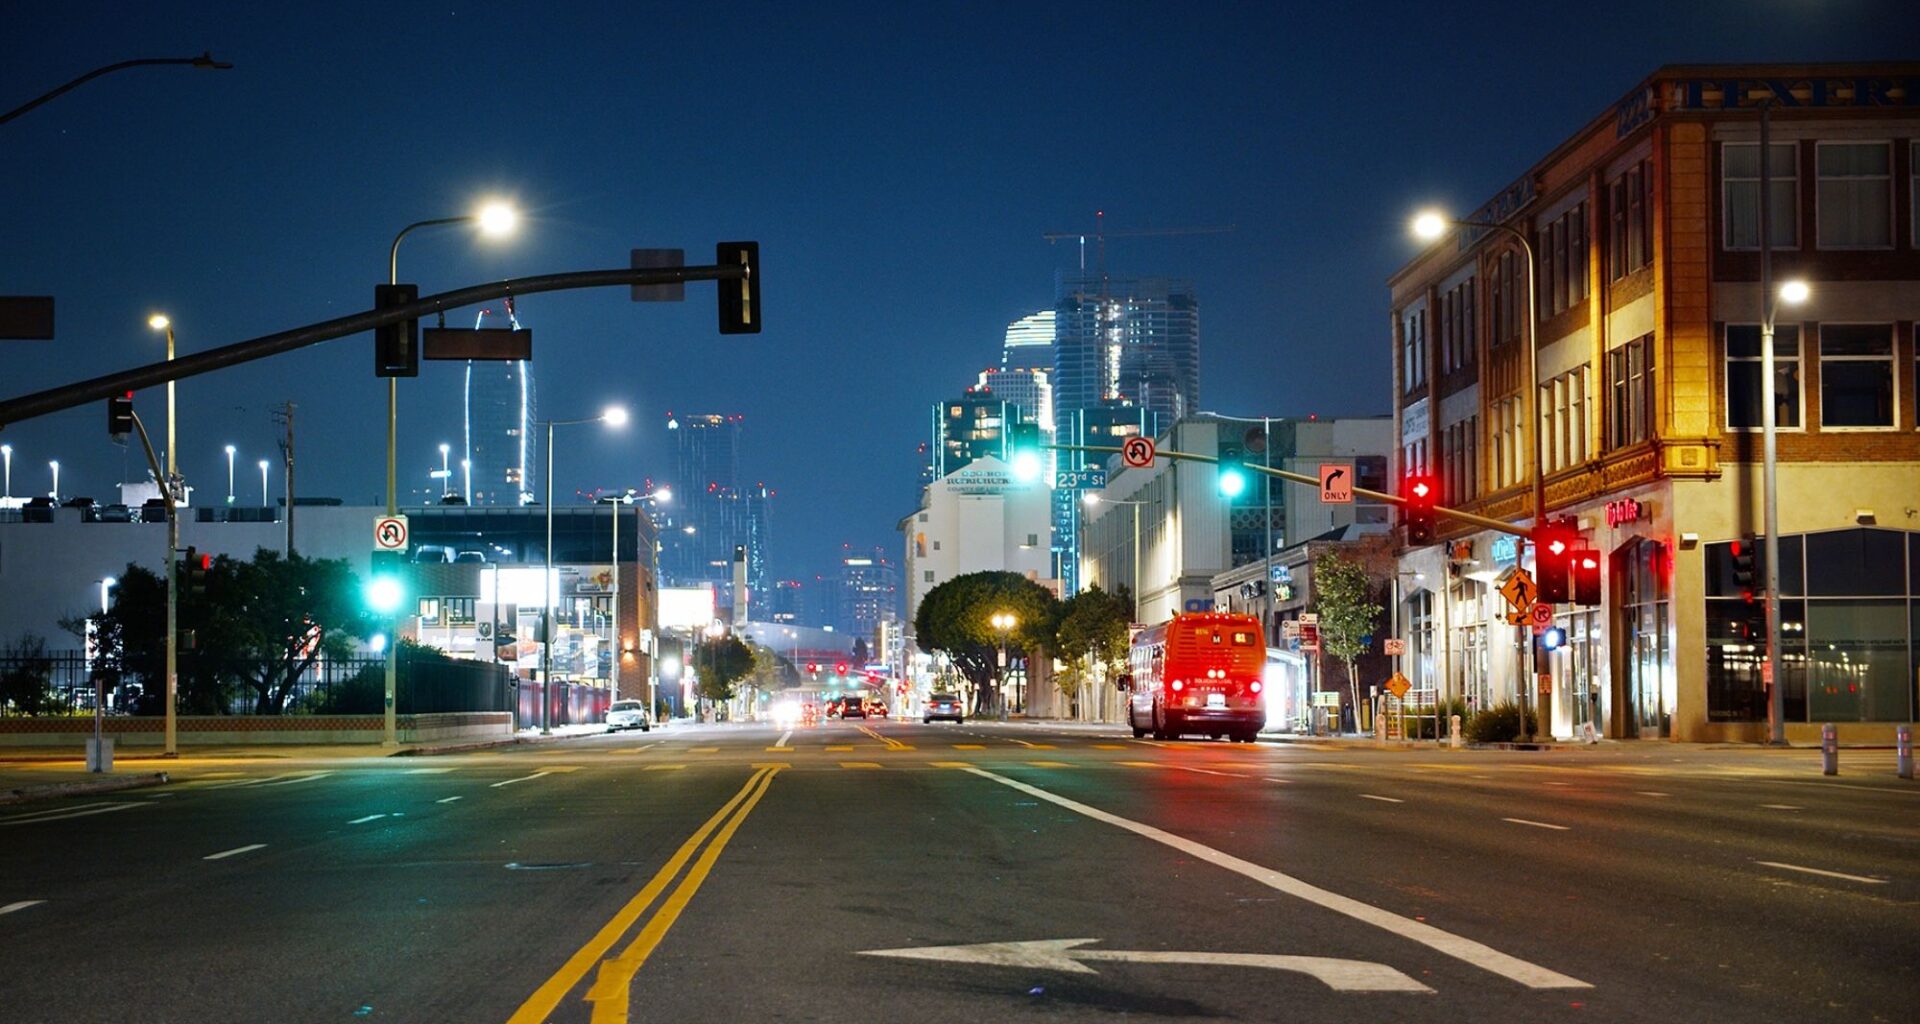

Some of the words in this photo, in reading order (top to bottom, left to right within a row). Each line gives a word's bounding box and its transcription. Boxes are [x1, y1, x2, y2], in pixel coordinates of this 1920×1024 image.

[1058, 472, 1087, 488] 23rd
[1091, 475, 1104, 485] St
[1324, 492, 1347, 500] ONLY
